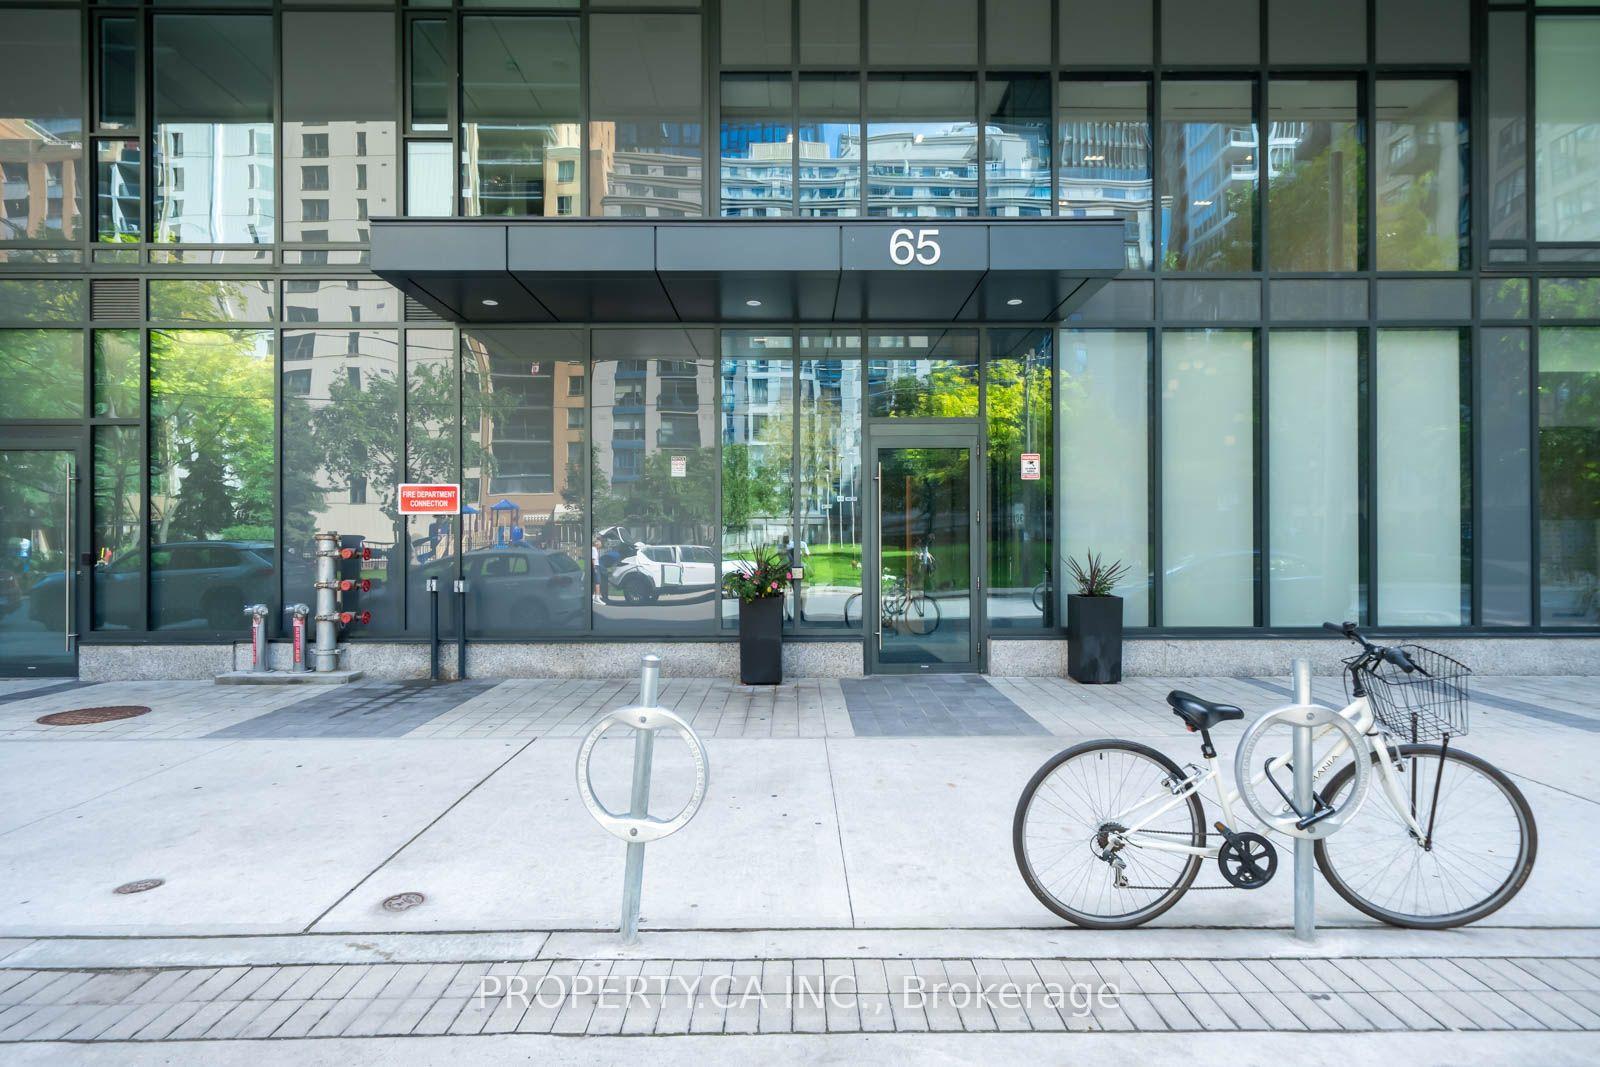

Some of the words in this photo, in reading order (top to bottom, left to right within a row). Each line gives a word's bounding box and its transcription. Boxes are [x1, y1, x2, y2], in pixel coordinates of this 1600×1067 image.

[889, 228, 941, 265] 65
[402, 490, 416, 498] FIRE
[416, 490, 455, 498] DEPARTMENT
